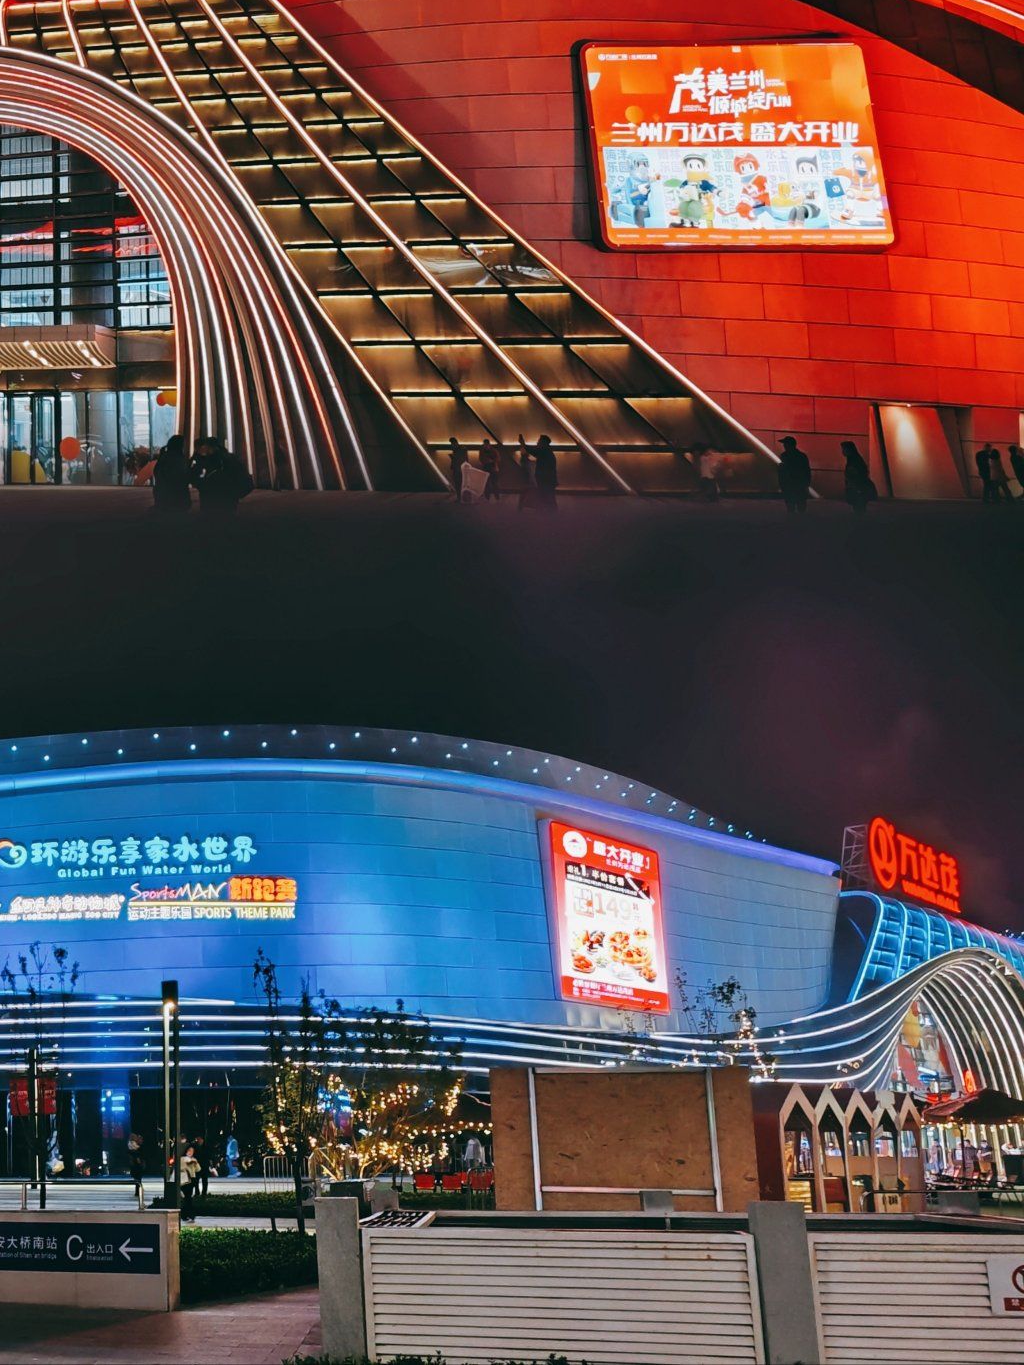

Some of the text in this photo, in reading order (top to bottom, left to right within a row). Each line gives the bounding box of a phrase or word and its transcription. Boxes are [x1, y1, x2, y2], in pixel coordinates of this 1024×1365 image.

[611, 122, 860, 142] 兰州万达茂 盛大开业
[30, 835, 257, 867] 环游乐享家水世界
[57, 863, 232, 878] Global Fun Water World
[896, 833, 961, 898] 万达茂
[194, 906, 296, 919] SPORTS THEME PARK
[66, 1234, 83, 1261] C
[86, 1243, 113, 1254] 出入口
